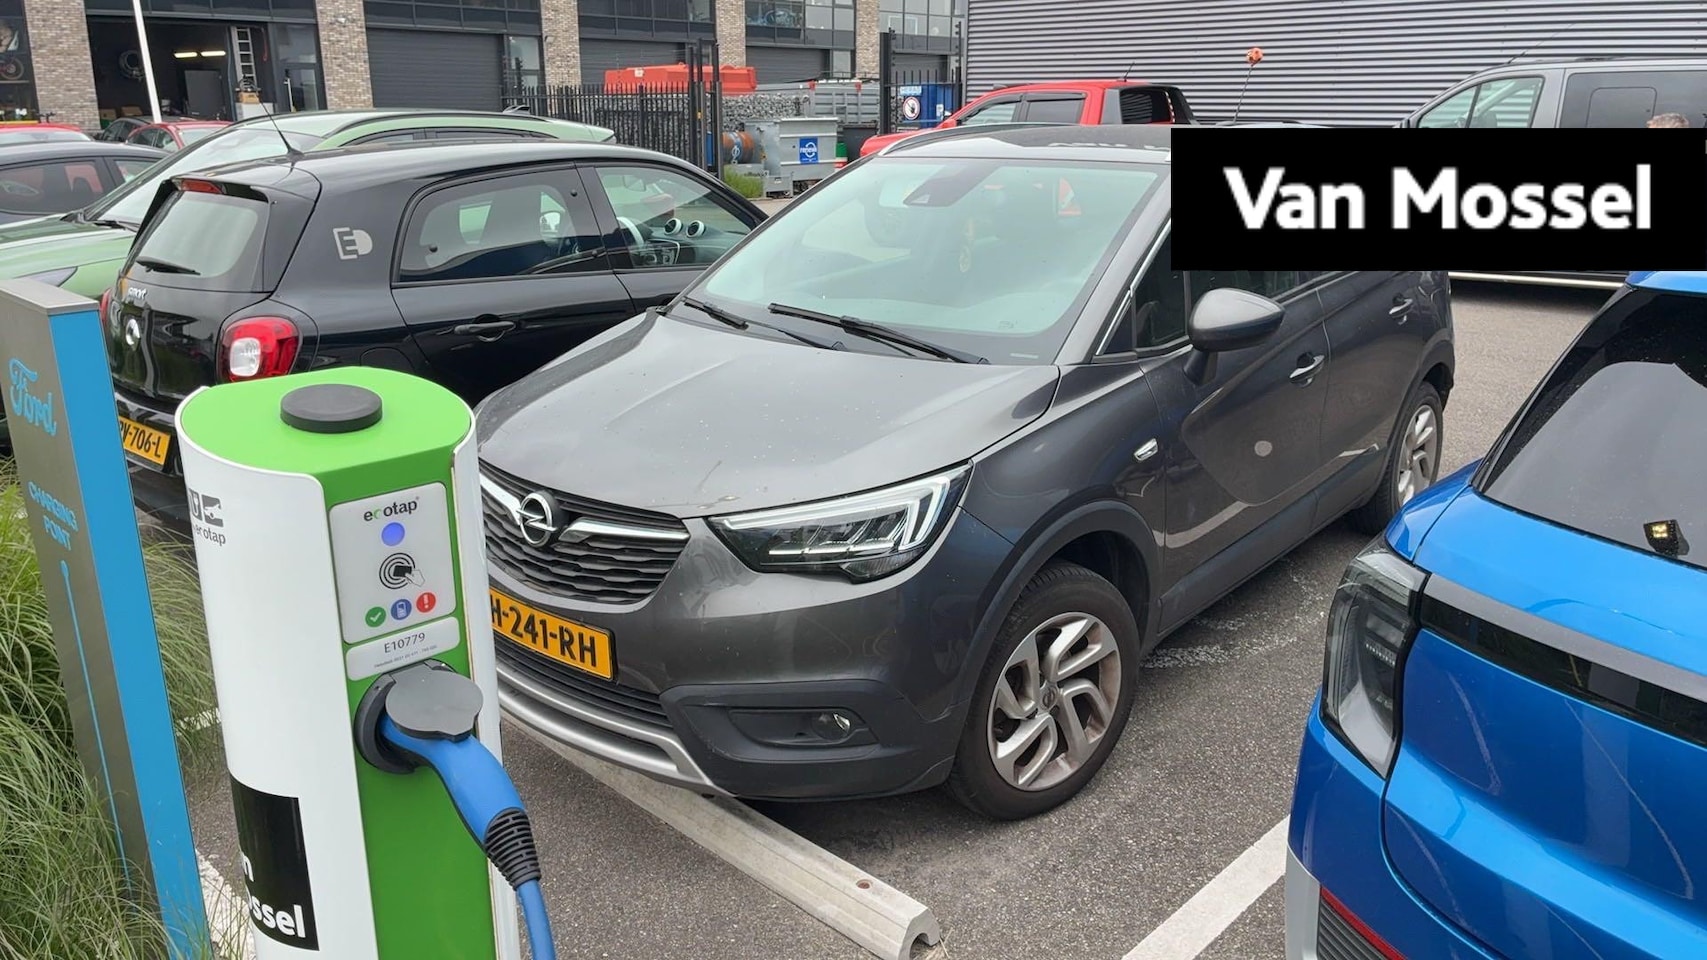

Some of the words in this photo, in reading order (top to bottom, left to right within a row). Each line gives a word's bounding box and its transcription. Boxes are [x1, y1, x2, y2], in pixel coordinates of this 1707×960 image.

[9, 358, 57, 436] Ford
[28, 481, 79, 532] CHARGING
[363, 500, 418, 521] ecotap
[43, 515, 72, 551] POINT
[383, 632, 426, 654] E10779
[490, 594, 597, 668] H-241-RH
[245, 884, 306, 938] ssel
